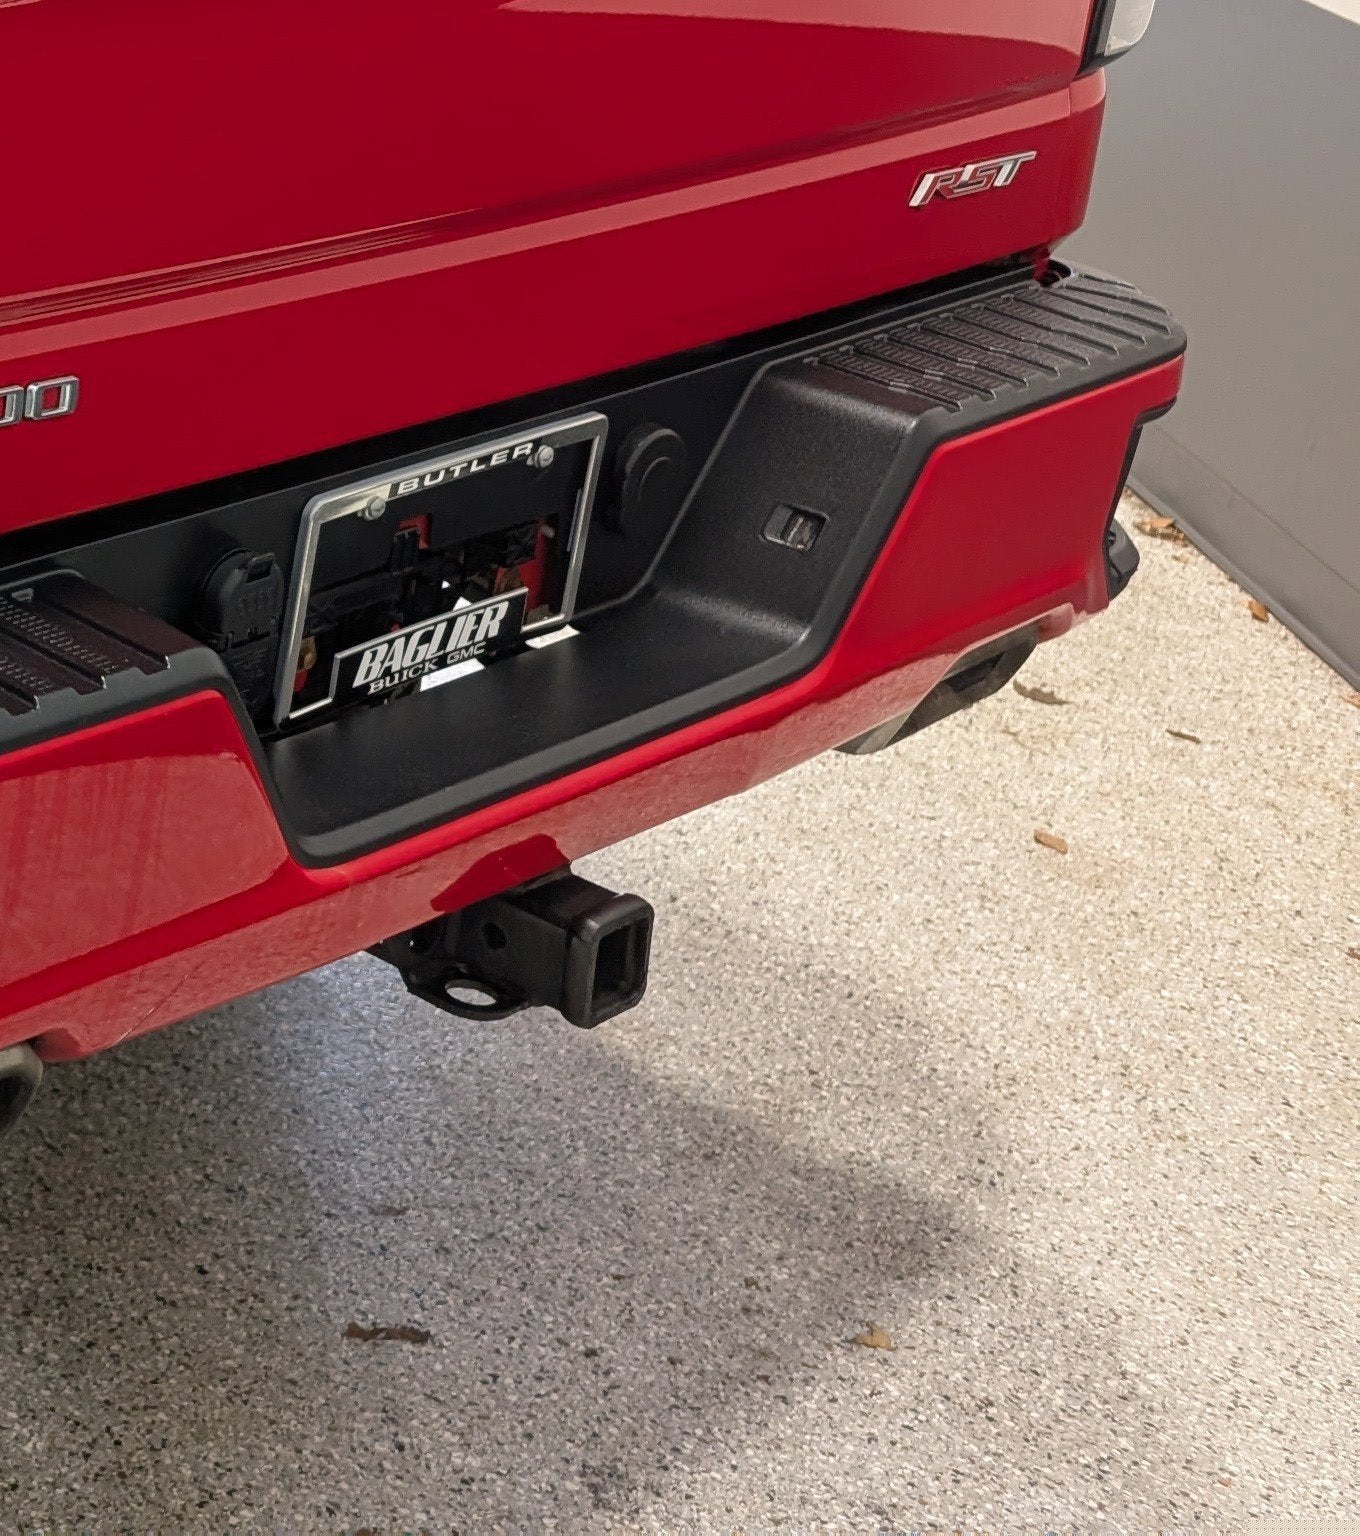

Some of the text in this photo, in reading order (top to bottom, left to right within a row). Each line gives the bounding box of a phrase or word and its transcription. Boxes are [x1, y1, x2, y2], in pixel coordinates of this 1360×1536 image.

[908, 150, 1038, 207] RST
[397, 442, 534, 495] BUTLER
[352, 600, 510, 689] BAGLIER
[367, 640, 487, 695] BUICK GMC
